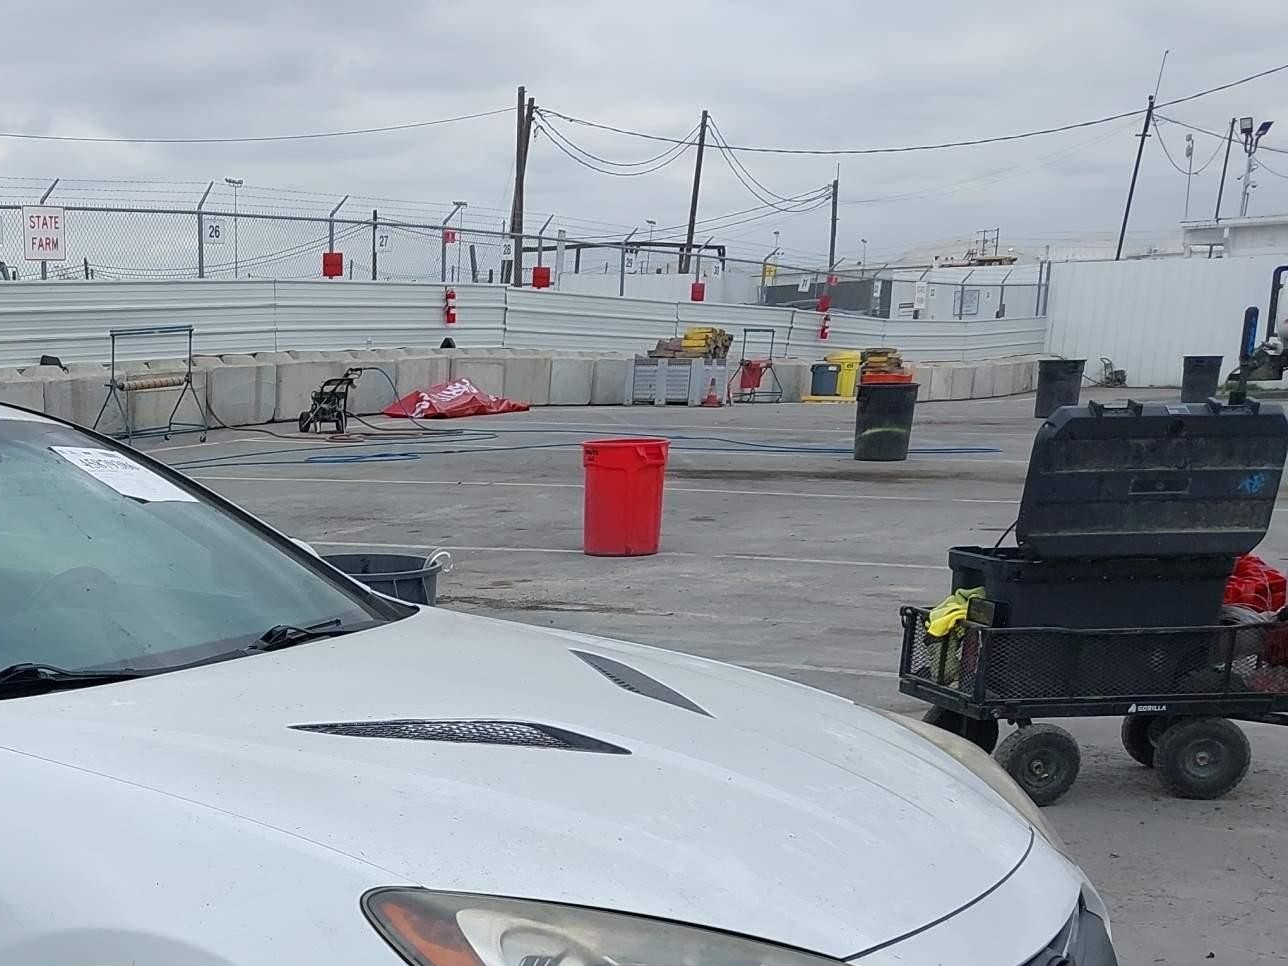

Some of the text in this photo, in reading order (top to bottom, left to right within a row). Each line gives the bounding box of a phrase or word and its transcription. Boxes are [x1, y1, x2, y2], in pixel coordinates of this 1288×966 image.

[29, 215, 60, 229] STATE
[208, 225, 221, 239] 26
[31, 236, 59, 251] FARM
[379, 235, 389, 248] 27
